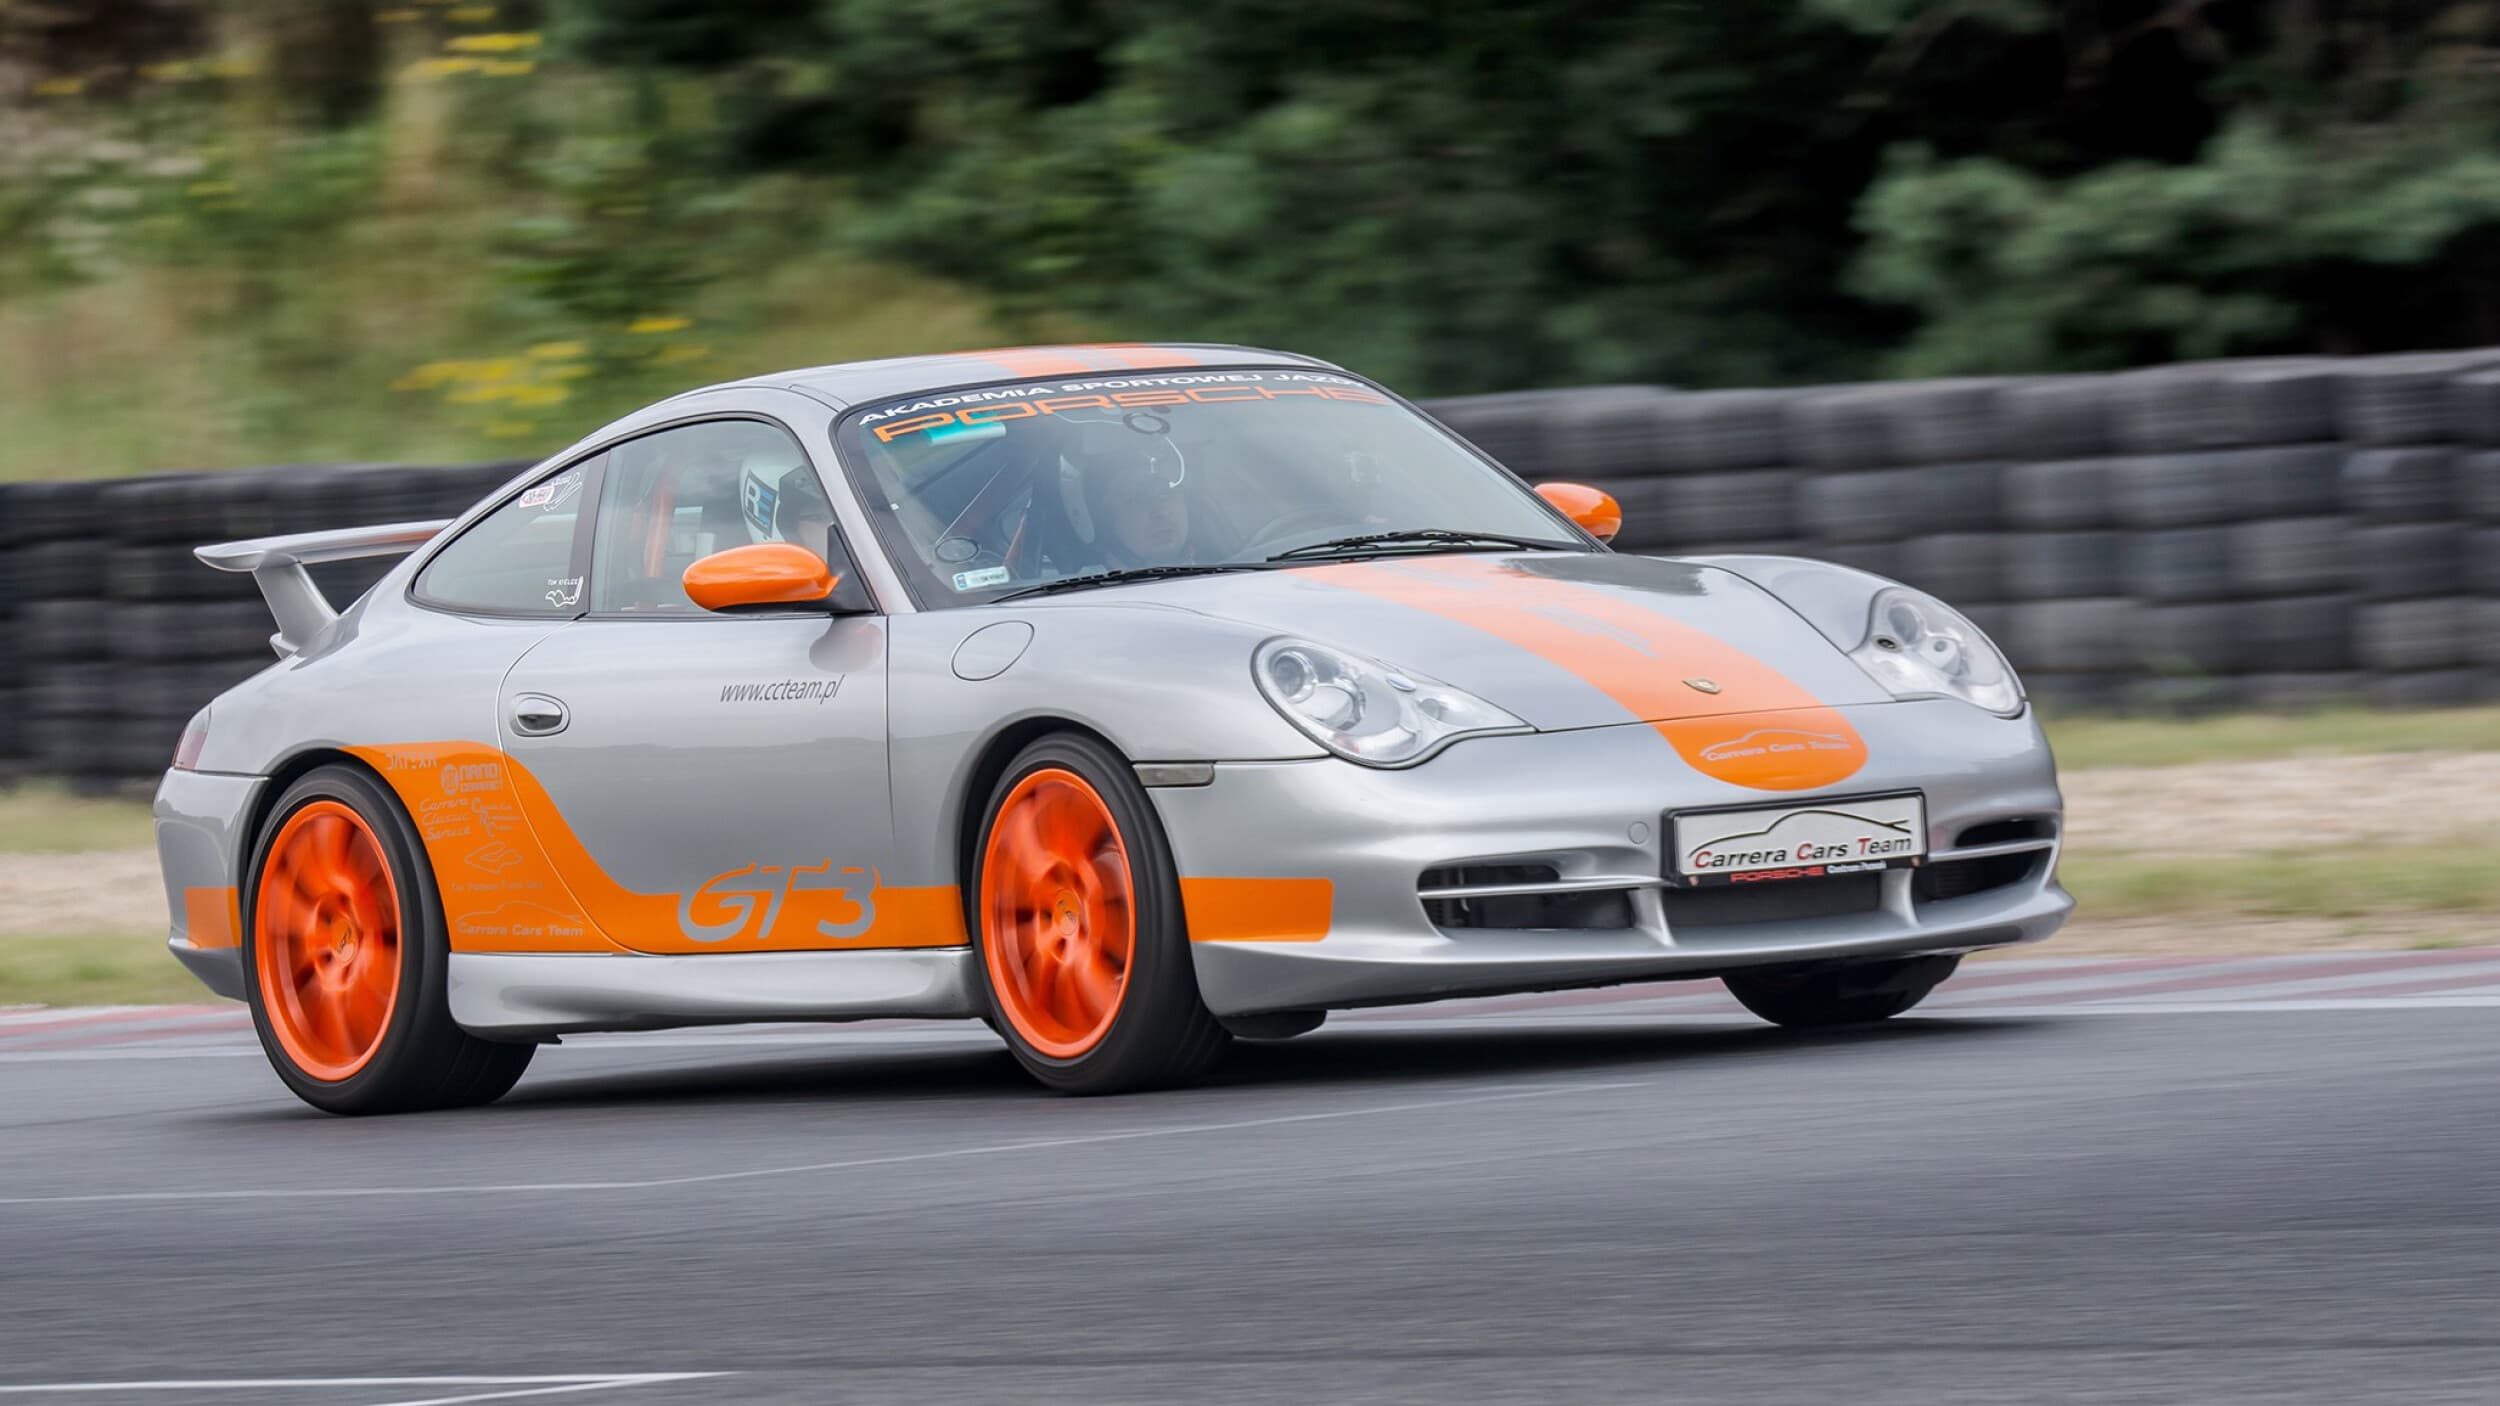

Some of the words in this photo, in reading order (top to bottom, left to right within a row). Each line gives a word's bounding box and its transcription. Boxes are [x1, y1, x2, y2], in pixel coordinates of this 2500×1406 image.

[858, 386, 1055, 426] AKADEMIA
[1061, 374, 1264, 391] SPORTOWEJ
[873, 385, 1393, 443] PORSCHE
[720, 673, 845, 704] www.ccteam.pl
[1705, 746, 1766, 762] Carrera
[1768, 742, 1805, 753] Cars
[1693, 849, 1787, 869] Carrera
[1796, 841, 1849, 860] Cars
[1857, 837, 1913, 856] Team
[1731, 865, 1825, 883] PORSCHE
[677, 857, 882, 943] GT3
[457, 922, 508, 936] Carrera
[511, 923, 543, 937] Cars
[547, 923, 585, 937] Team
